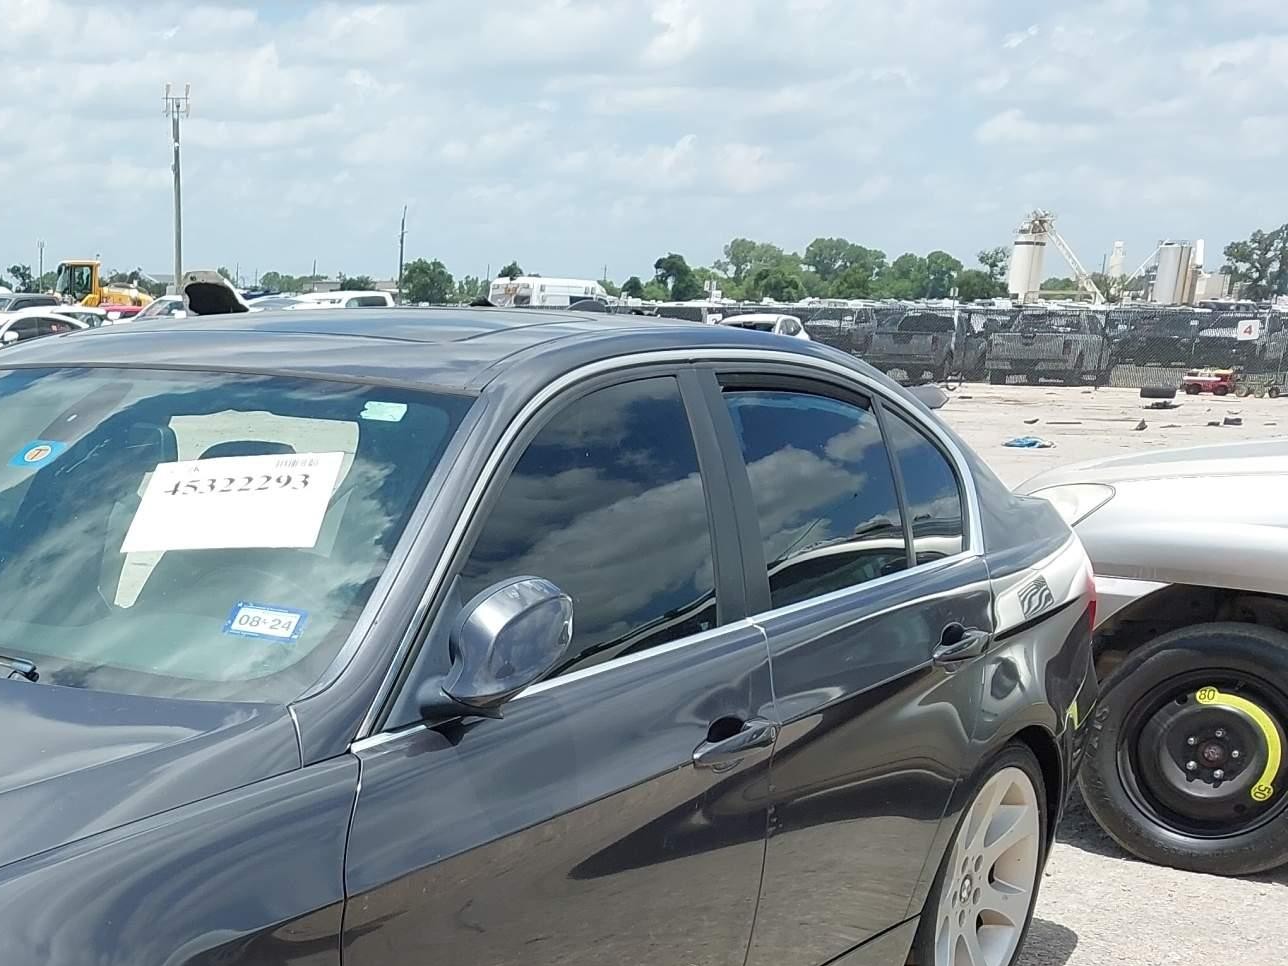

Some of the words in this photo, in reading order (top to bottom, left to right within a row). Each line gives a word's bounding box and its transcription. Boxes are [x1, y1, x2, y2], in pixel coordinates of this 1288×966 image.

[1243, 324, 1253, 336] 4
[163, 473, 311, 496] 45322293
[1198, 688, 1216, 701] 80
[1253, 784, 1272, 800] 50
